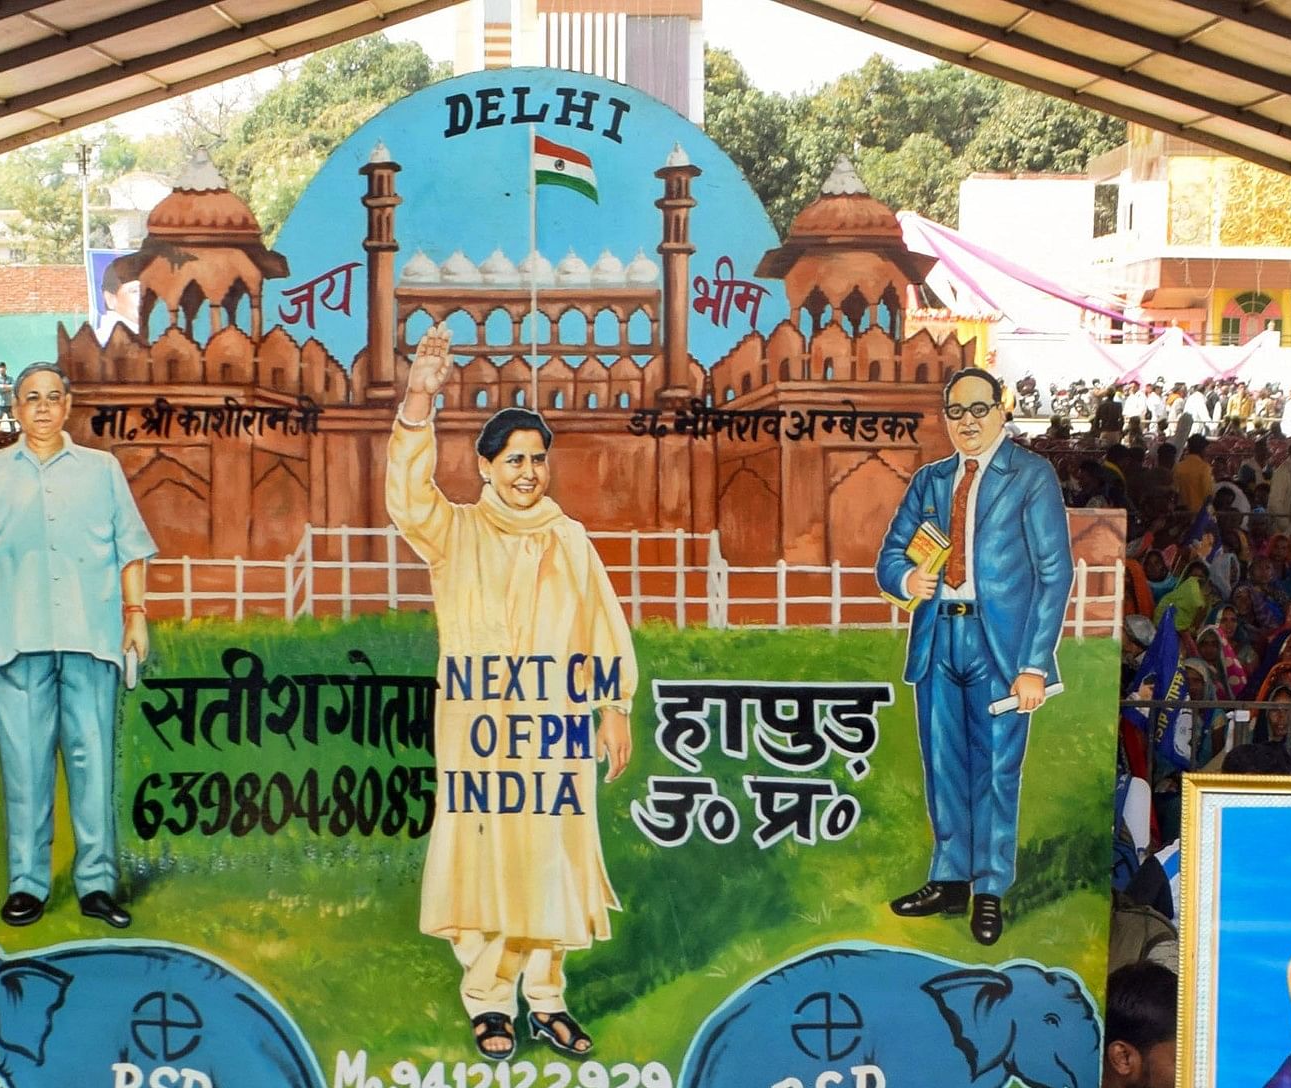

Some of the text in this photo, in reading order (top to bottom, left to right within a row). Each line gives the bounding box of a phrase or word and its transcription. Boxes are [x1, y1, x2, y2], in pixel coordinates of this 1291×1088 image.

[443, 86, 631, 144] DELHI
[278, 261, 364, 329] जय
[692, 255, 773, 329] भीम
[446, 653, 622, 703] NEXT CM
[652, 679, 895, 782] हापुड़
[132, 765, 438, 841] 6398048085
[444, 770, 586, 816] INDIA
